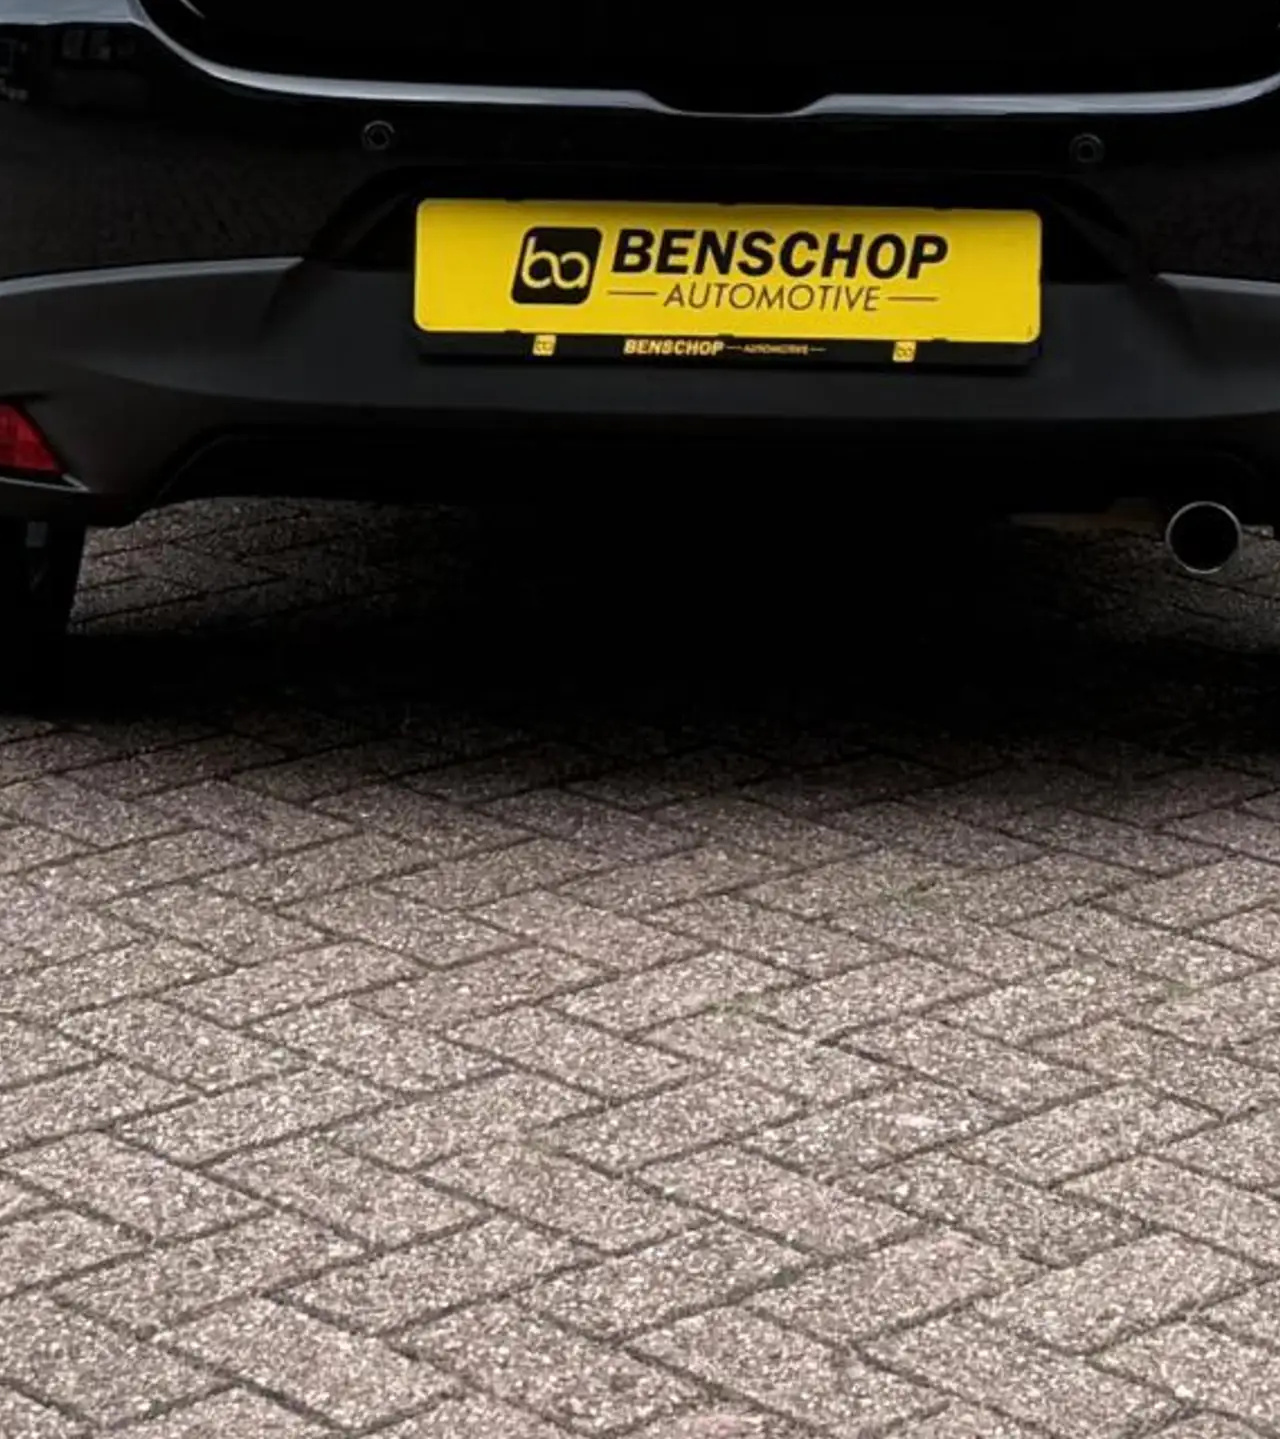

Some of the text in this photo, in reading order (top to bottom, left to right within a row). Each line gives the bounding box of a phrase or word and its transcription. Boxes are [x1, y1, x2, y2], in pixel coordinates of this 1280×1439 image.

[610, 228, 948, 279] BENSCHOP
[662, 282, 881, 312] AUTOMOTIVE
[623, 338, 724, 356] BENSCHOP
